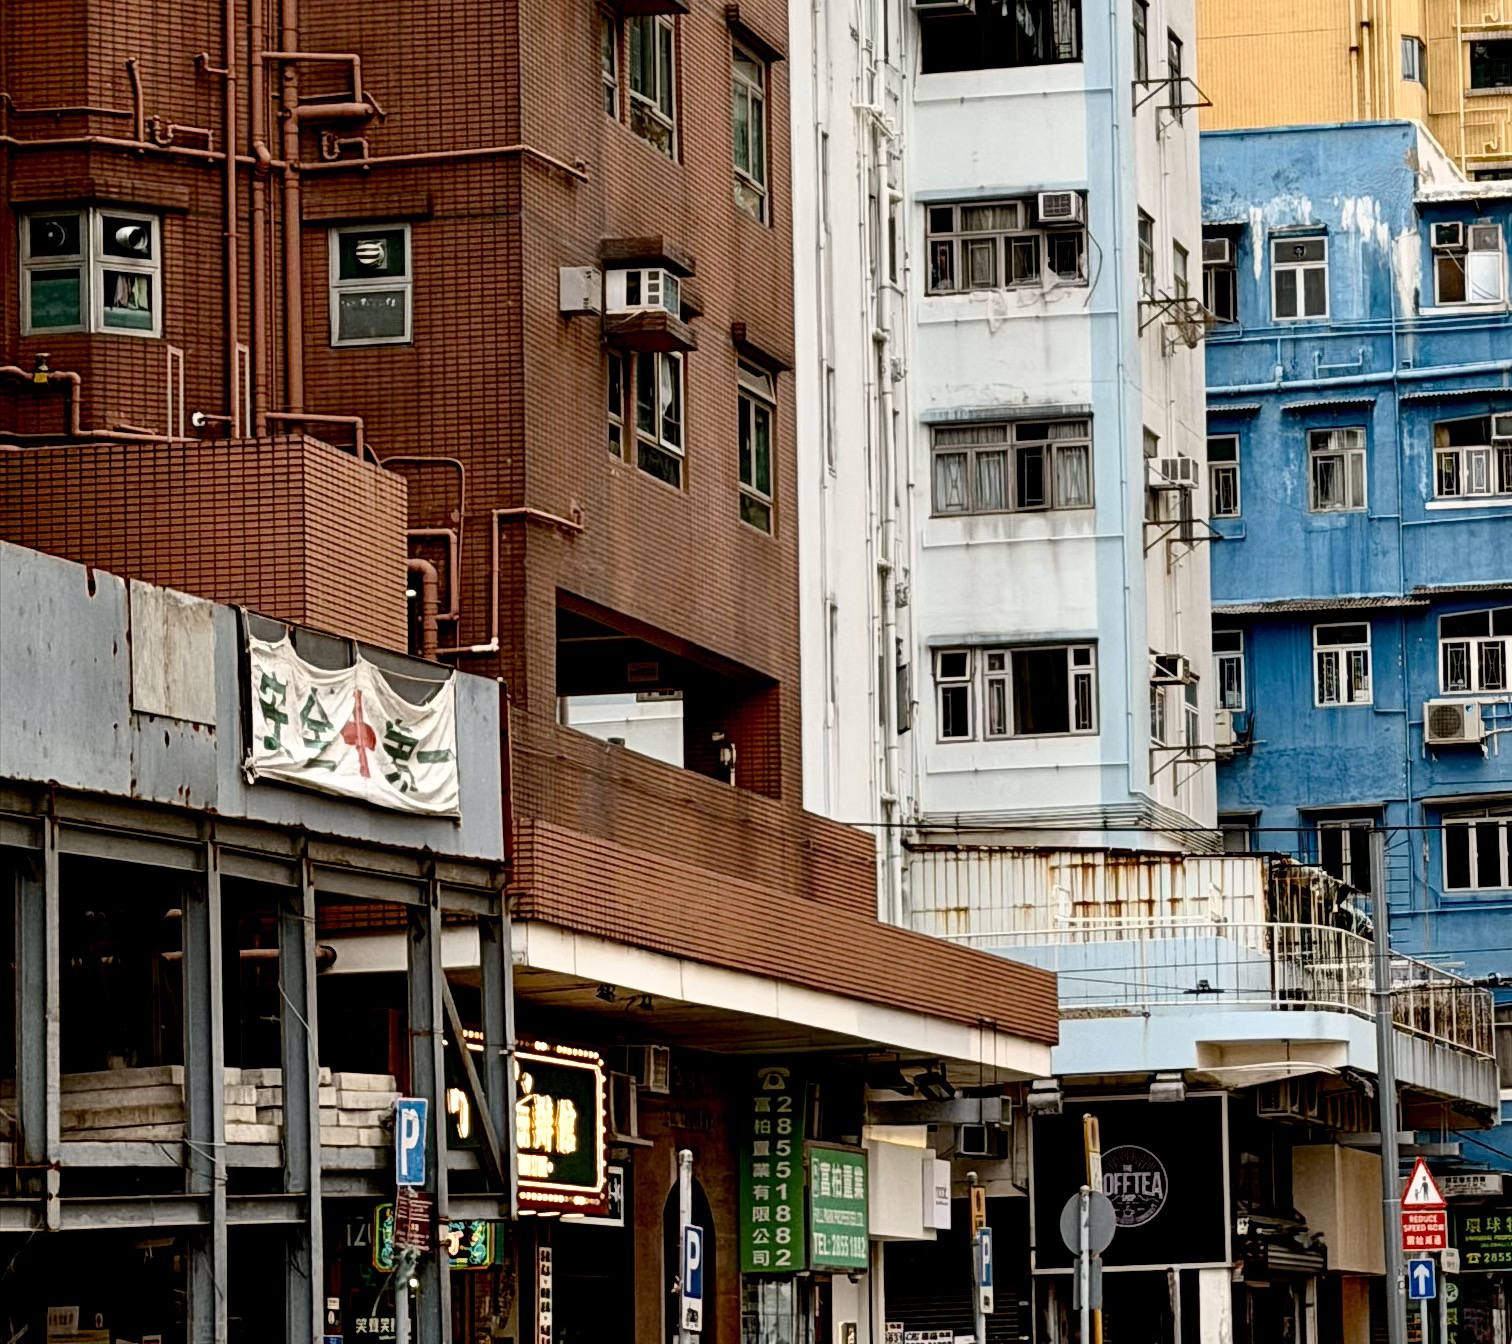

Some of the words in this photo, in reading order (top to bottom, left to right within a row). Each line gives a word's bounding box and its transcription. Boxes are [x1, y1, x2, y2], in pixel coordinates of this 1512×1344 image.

[401, 1108, 420, 1176] P
[775, 1096, 793, 1267] 28551882
[1103, 1172, 1164, 1199] OFFTEA
[687, 1231, 700, 1293] P
